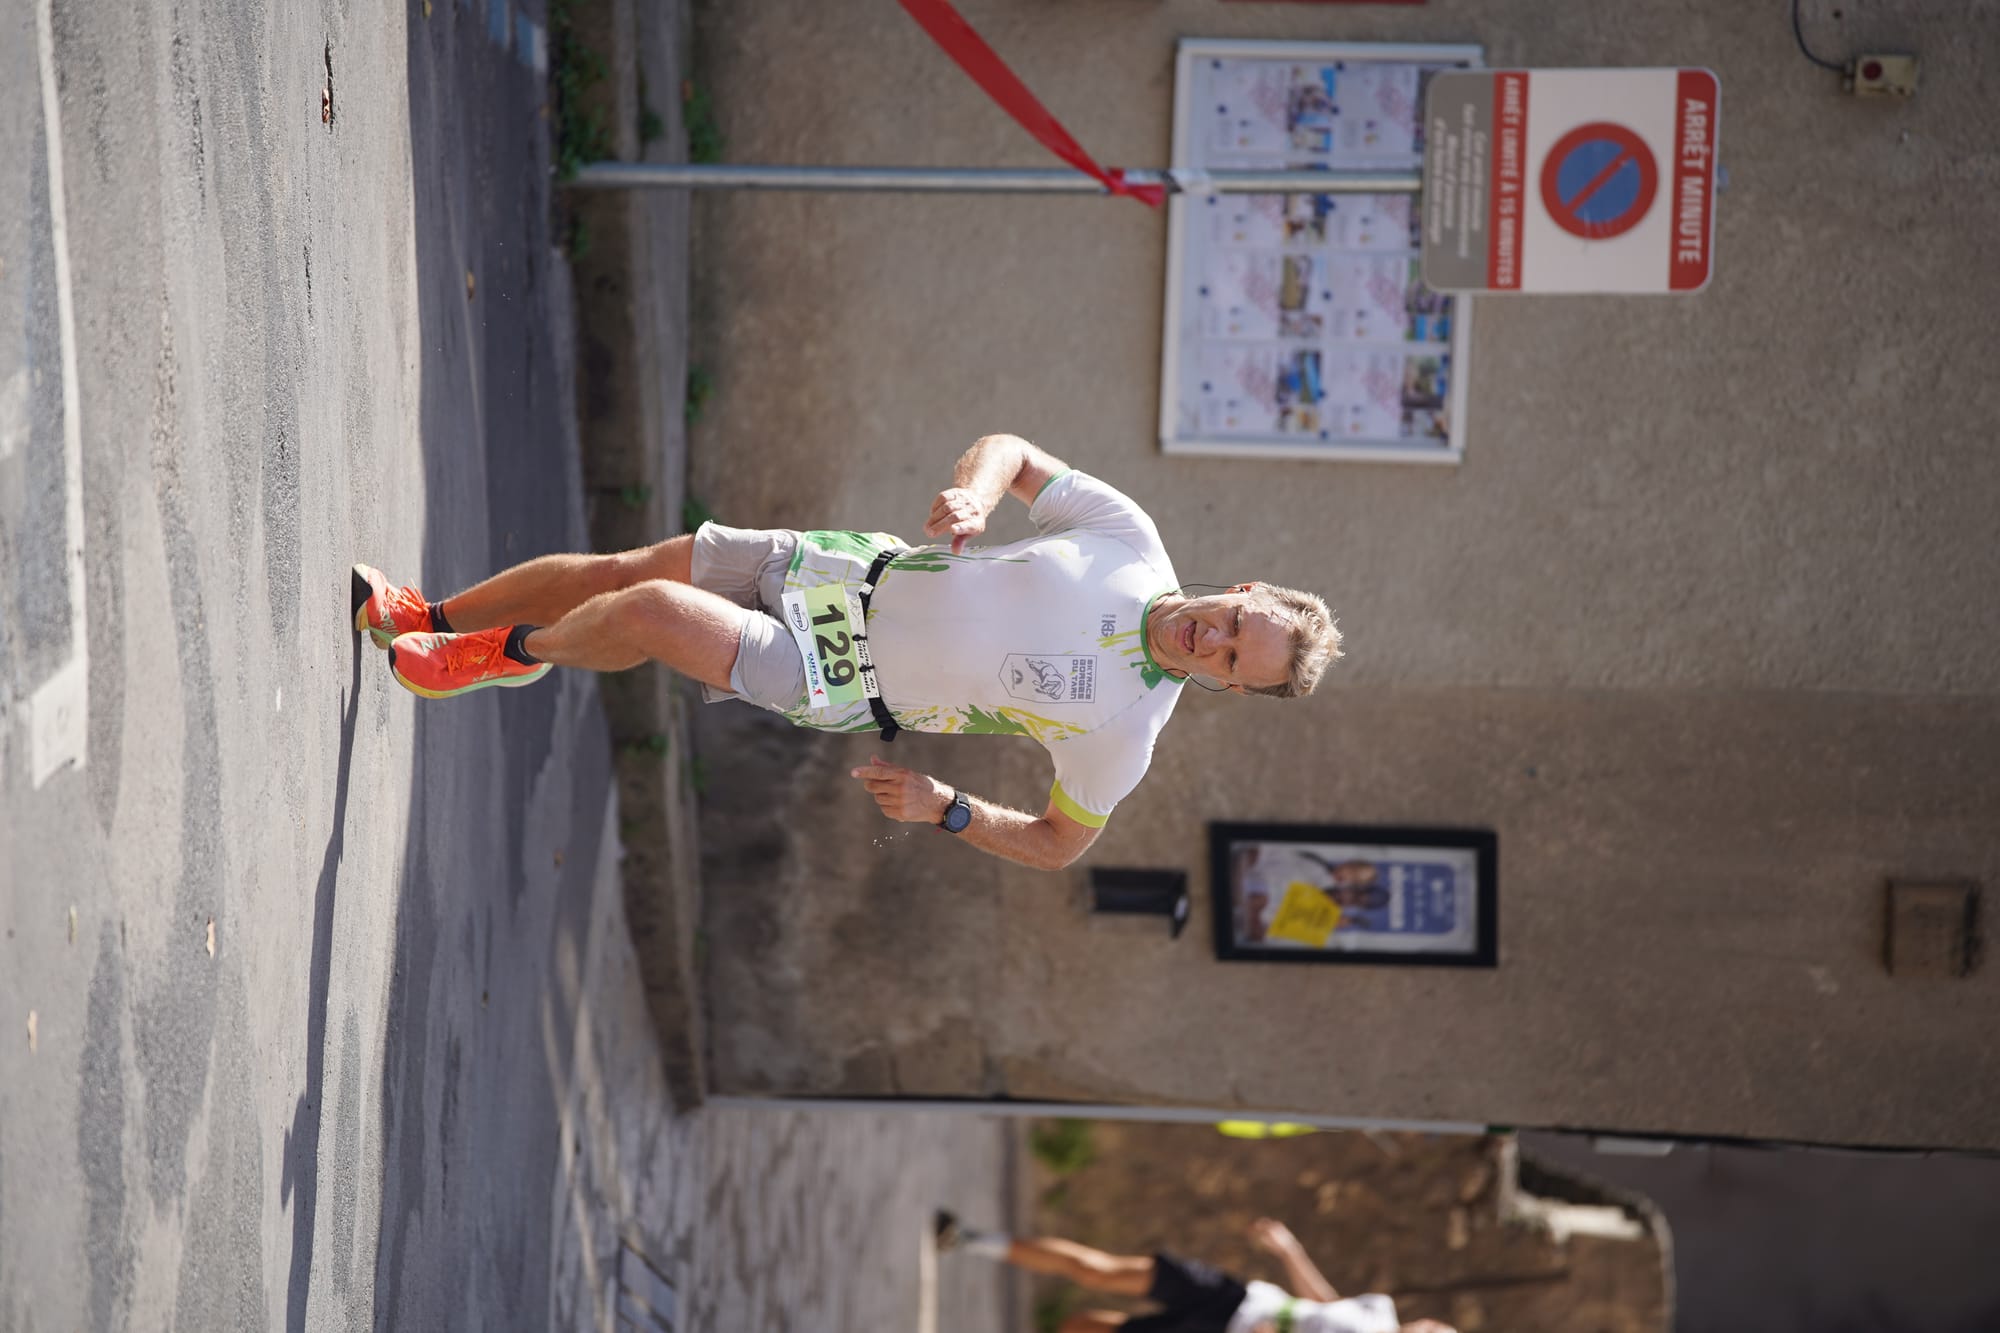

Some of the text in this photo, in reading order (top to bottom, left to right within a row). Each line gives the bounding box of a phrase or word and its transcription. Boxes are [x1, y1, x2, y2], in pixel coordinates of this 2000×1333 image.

[1503, 77, 1522, 124] ARRÊT
[1678, 98, 1711, 263] ARRÊT MINUTE
[1499, 198, 1516, 214] 15
[1496, 218, 1515, 286] MINUTES
[812, 604, 855, 686] 129
[1072, 659, 1078, 672] DU
[1078, 659, 1086, 700] GORGES
